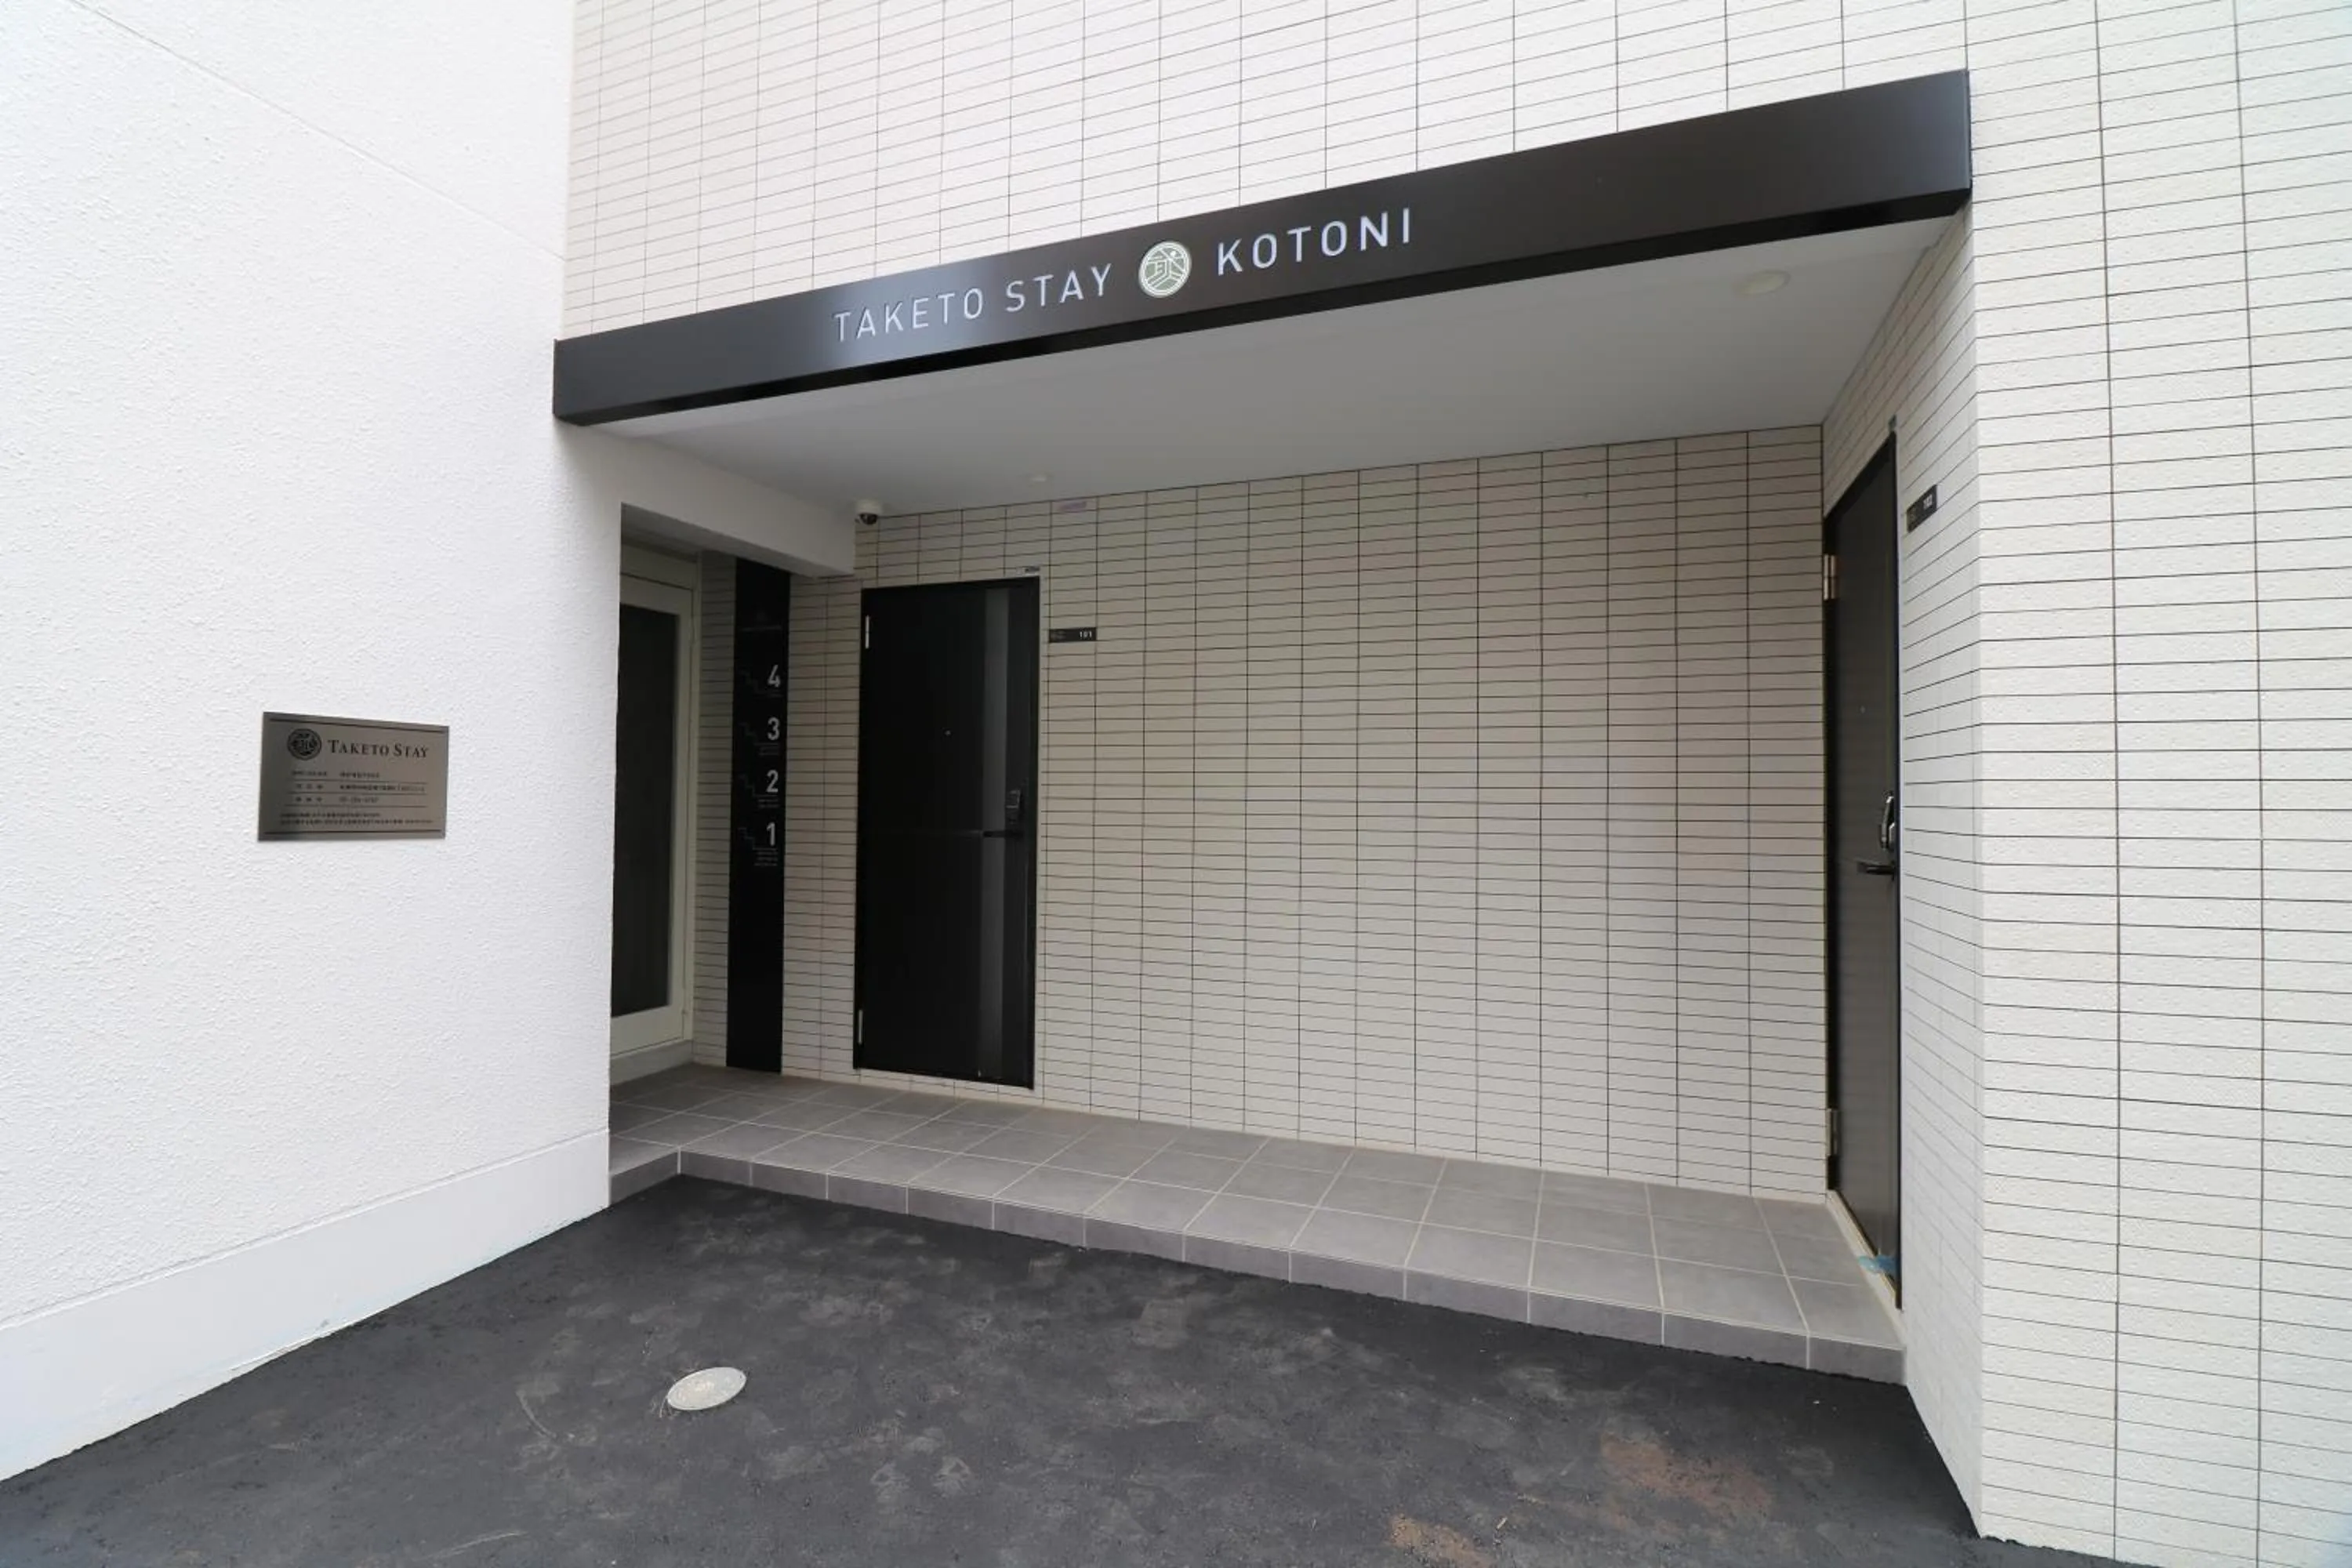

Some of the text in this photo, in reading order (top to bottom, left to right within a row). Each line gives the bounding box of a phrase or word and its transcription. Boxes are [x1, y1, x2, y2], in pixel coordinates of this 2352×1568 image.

[834, 207, 1410, 343] TAKETO STAY KOTONI
[768, 664, 781, 688] 4
[767, 717, 780, 741] 3
[766, 770, 779, 793] 2
[766, 822, 775, 847] 1
